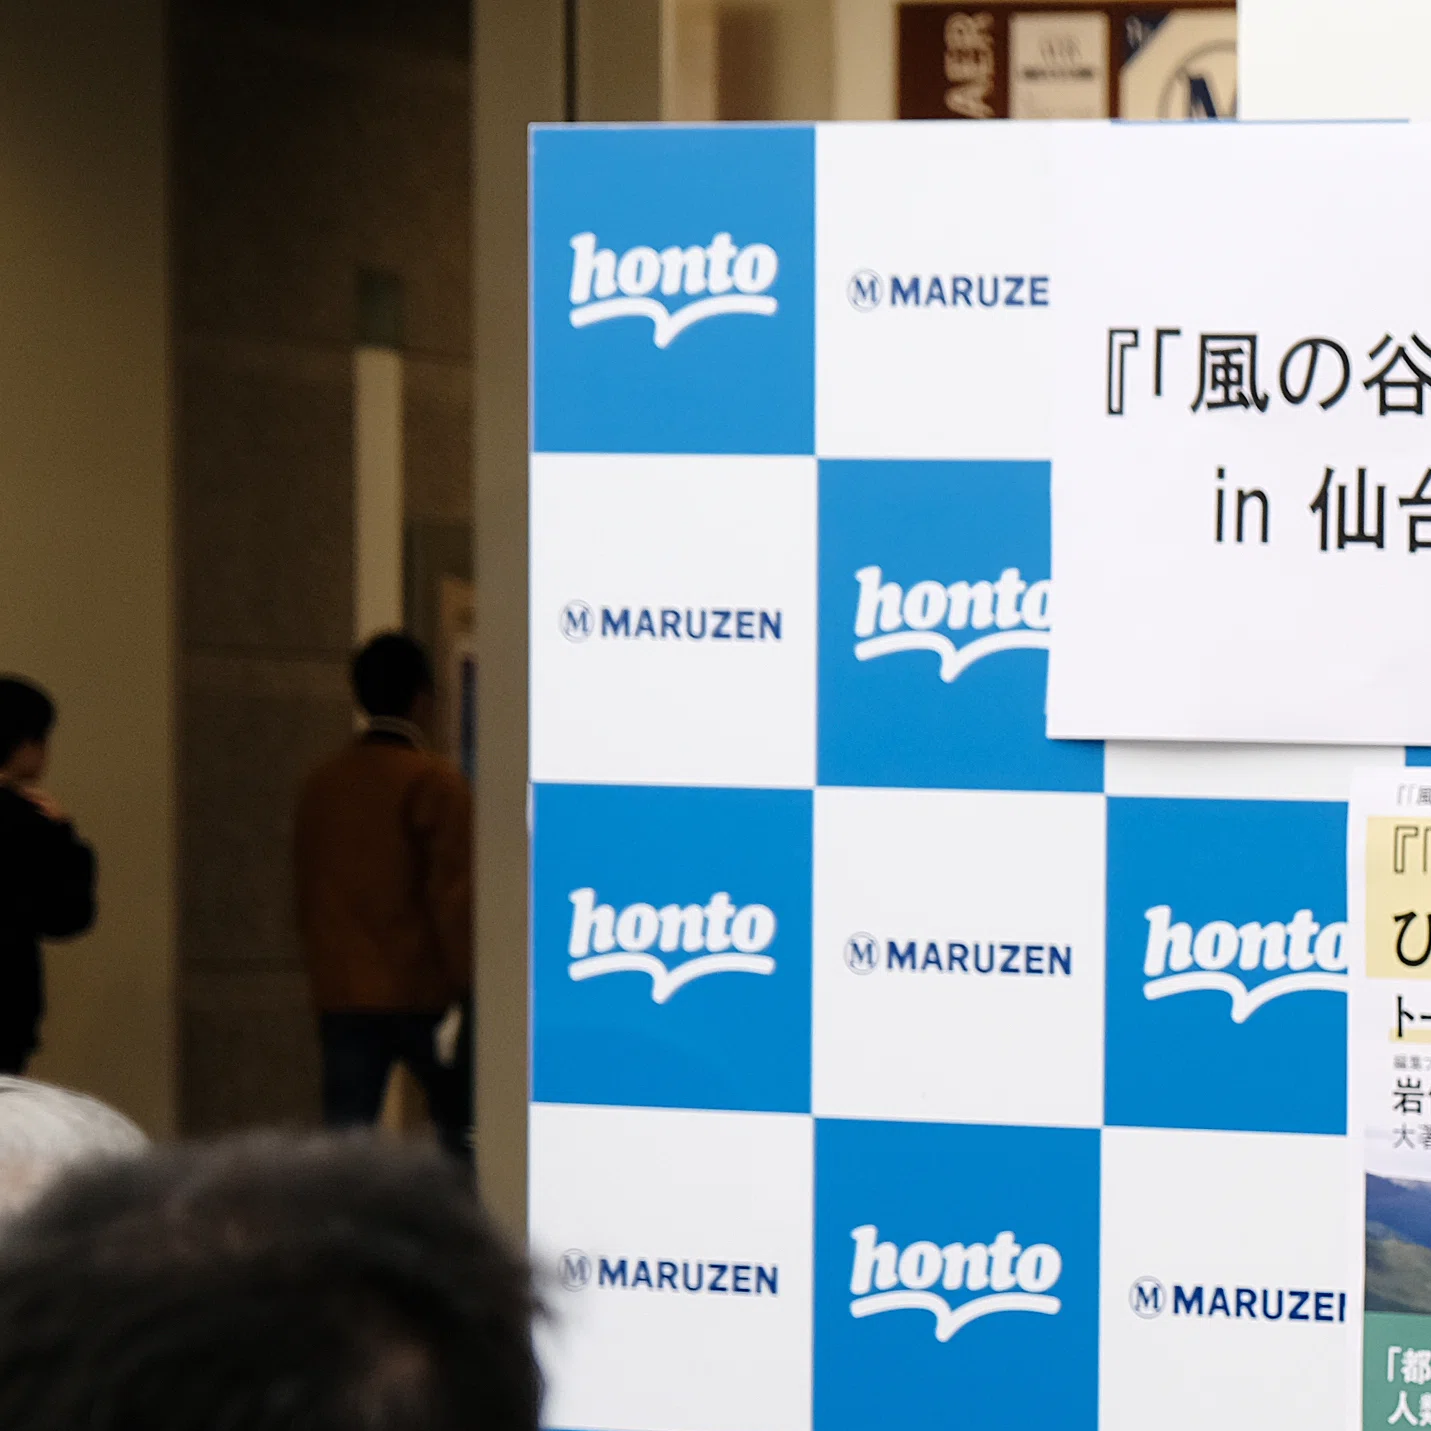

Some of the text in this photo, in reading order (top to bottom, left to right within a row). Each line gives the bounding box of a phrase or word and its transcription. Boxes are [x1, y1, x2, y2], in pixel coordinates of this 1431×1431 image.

[571, 232, 778, 303] honto
[891, 275, 1049, 308] MARUZE
[1216, 467, 1269, 543] in
[601, 607, 782, 641] MARUZEN
[569, 887, 777, 957] honto
[887, 940, 1072, 977] MARUZEN
[599, 1256, 779, 1296] MARUZEN
[850, 1224, 1062, 1297] honto
[1172, 1284, 1347, 1324] MARUZE
